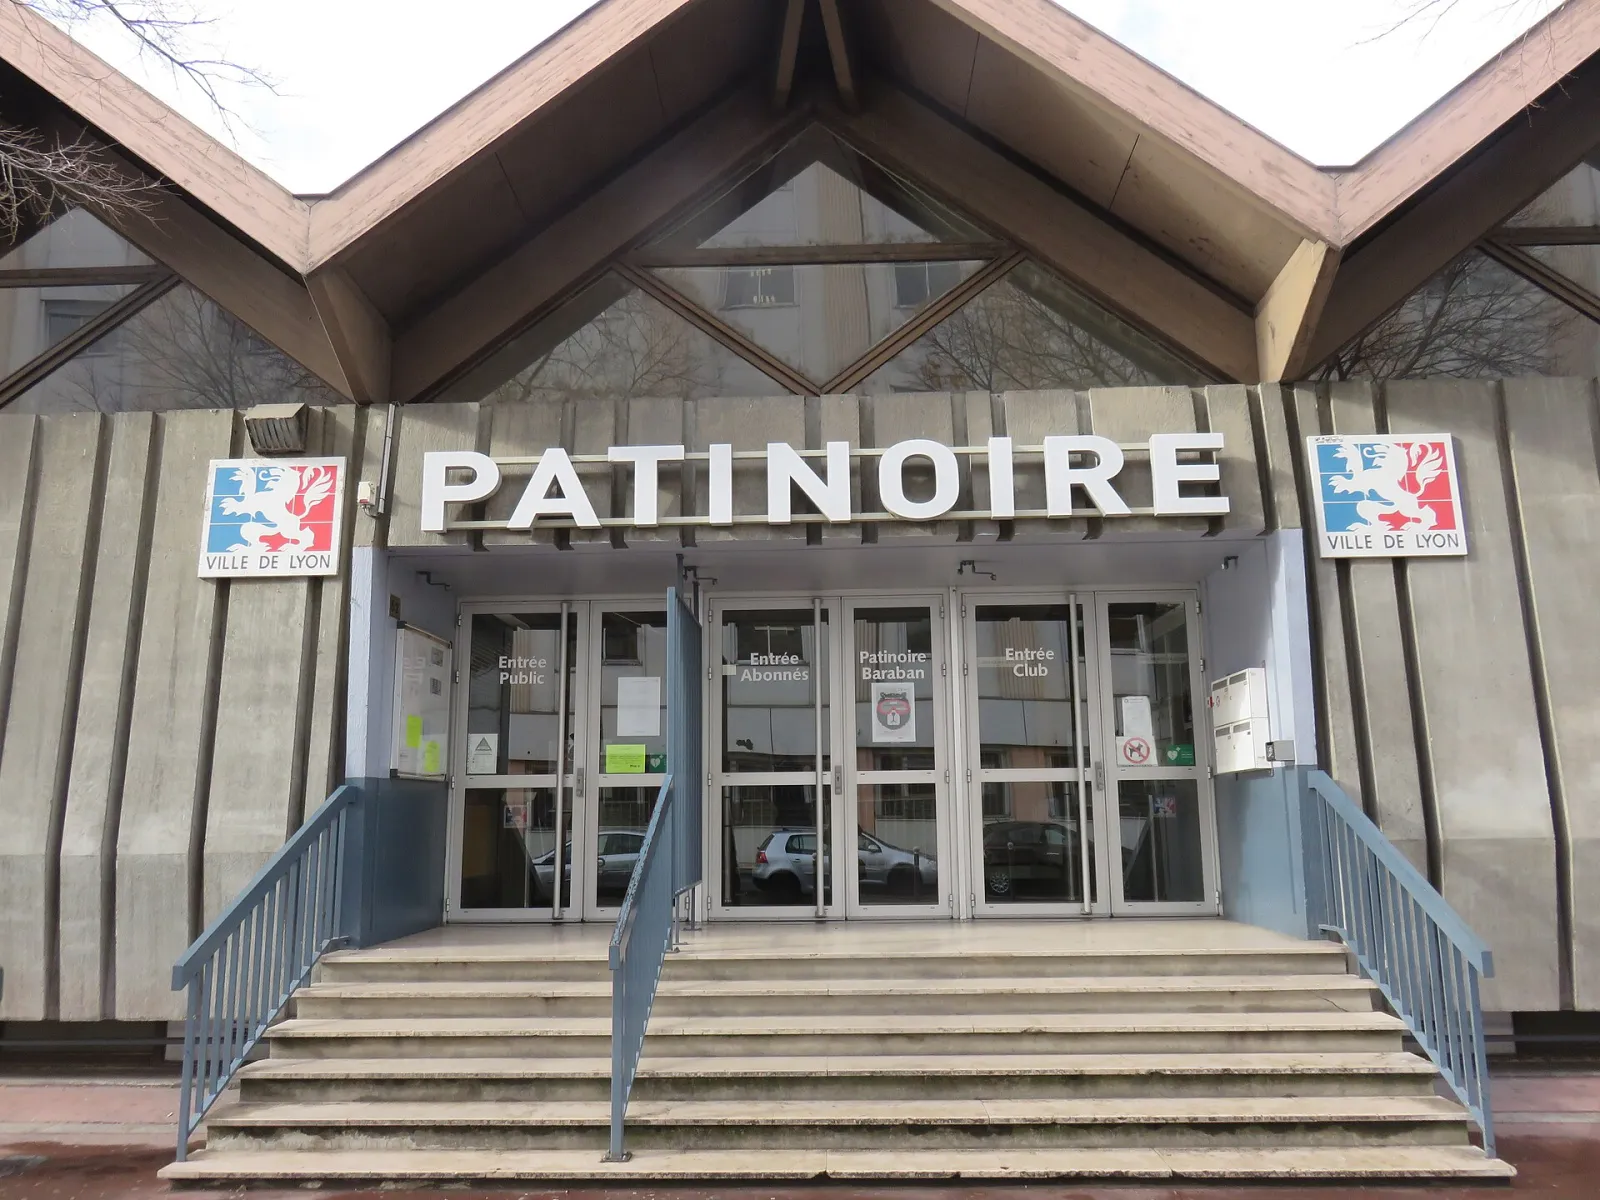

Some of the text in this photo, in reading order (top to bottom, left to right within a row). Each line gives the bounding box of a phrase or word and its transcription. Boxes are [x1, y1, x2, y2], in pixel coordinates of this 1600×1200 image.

[422, 432, 1232, 533] PATINOIRE
[1328, 533, 1460, 549] VILLE DE LYON
[206, 554, 331, 570] VILLE DE LYON
[750, 651, 799, 665] Entrée
[859, 650, 927, 664] Patinoire
[1004, 646, 1056, 661] Entrée
[498, 655, 547, 669] Entrée
[499, 671, 545, 685] Public
[740, 667, 809, 682] Abonnés
[862, 666, 925, 680] Baraban
[1013, 663, 1048, 678] Club
